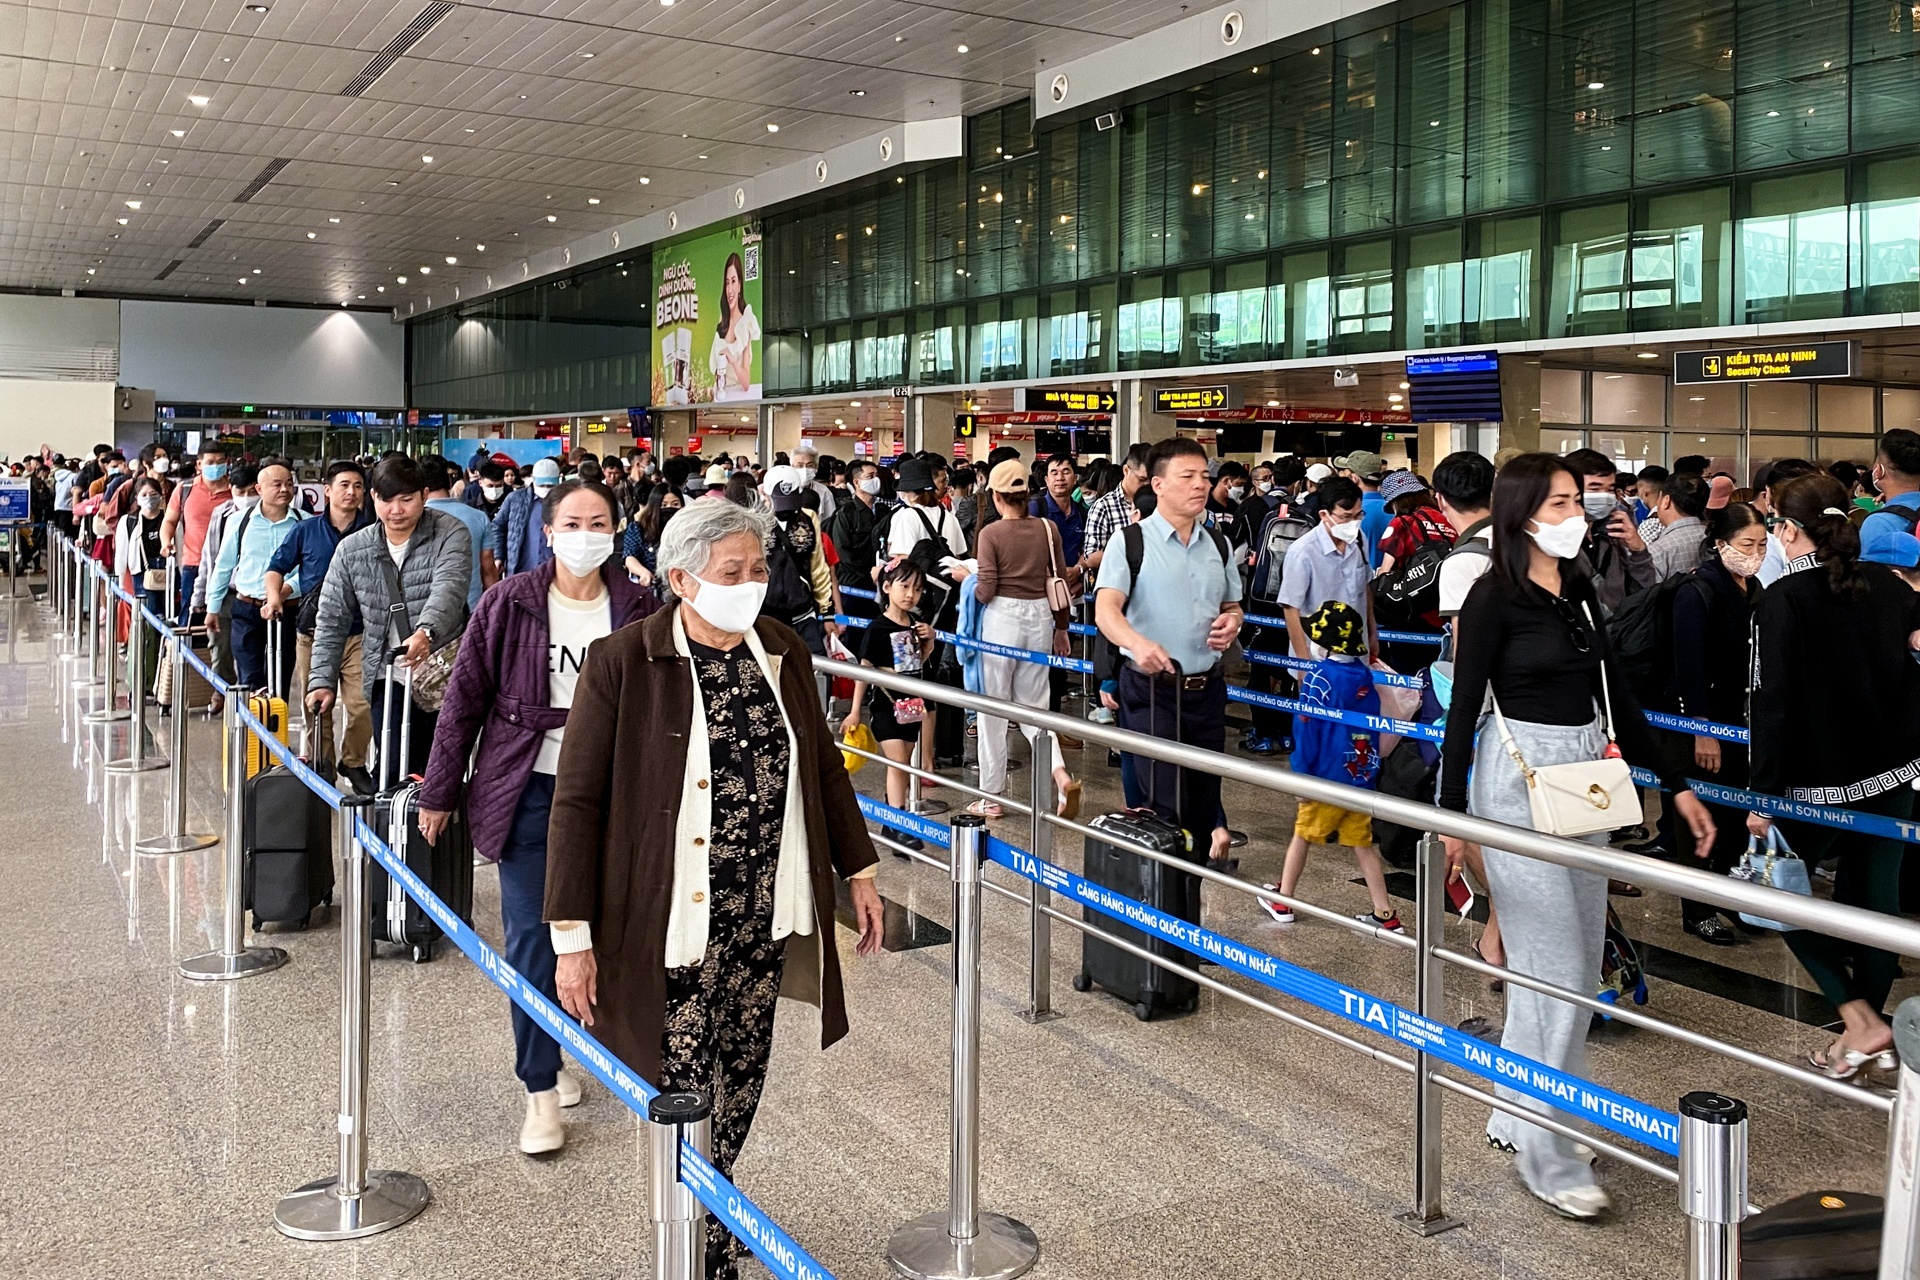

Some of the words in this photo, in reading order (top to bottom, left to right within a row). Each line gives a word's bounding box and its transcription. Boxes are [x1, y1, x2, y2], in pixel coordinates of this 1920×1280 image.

[677, 258, 690, 278] CỐC
[659, 281, 673, 298] DINH
[656, 294, 698, 327] BEONE
[1727, 351, 1750, 365] KIỂM
[1753, 354, 1772, 364] TRA
[1775, 352, 1789, 362] AN
[1791, 351, 1816, 361] NINH
[1726, 367, 1761, 376] Security
[1762, 365, 1790, 374] Check
[1262, 408, 1274, 418] K-1
[1282, 410, 1294, 419] K-2
[1360, 411, 1372, 421] K-3
[961, 416, 972, 436] J
[848, 617, 858, 626] TIA
[1047, 655, 1064, 667] TIA
[1282, 657, 1298, 668] KHÔNG
[1300, 661, 1314, 670] QUỐC
[1385, 674, 1407, 686] TIA
[1241, 690, 1256, 701] HÀNG
[1257, 694, 1276, 706] KHÔNG
[1277, 698, 1292, 710] QUỐC
[1293, 701, 1300, 711] TẾ
[1301, 704, 1312, 714] TÂN
[1366, 716, 1390, 730] TIA
[1424, 727, 1438, 738] TAN
[1654, 714, 1676, 726] HÀNG
[1678, 720, 1708, 732] KHÔNG
[1710, 726, 1735, 738] QUỐC
[1737, 728, 1749, 740] TẾ
[1631, 768, 1652, 783] ẢNG
[1690, 783, 1720, 798] HÔNG
[1722, 790, 1752, 805] QUỐC
[1755, 796, 1769, 810] TẾ
[1771, 798, 1793, 814] TÂN
[1796, 804, 1820, 820] SƠN
[1823, 810, 1855, 826] NHẤT
[874, 805, 922, 833] INTERNATIONAL
[358, 822, 370, 846] TIA
[1010, 850, 1038, 878] TIA
[1077, 882, 1100, 903] CẢNG
[1100, 894, 1124, 914] HÀNG
[1126, 904, 1158, 928] KHÔNG
[1159, 918, 1186, 940] QUỐC
[1187, 929, 1200, 948] TẾ
[1202, 936, 1222, 956] TÂN
[1224, 946, 1246, 966] SƠN
[1249, 956, 1278, 978] NHẤT
[479, 941, 498, 976] TIA
[1338, 989, 1389, 1030] TIA
[1398, 1010, 1410, 1022] TAN
[1411, 1016, 1426, 1028] SON
[1426, 1022, 1444, 1036] NHAT
[1398, 1020, 1448, 1047] INTERNATIONAL
[1398, 1030, 1426, 1048] AIRPORT
[522, 984, 534, 1008] TAN
[534, 996, 547, 1018] SON
[547, 1007, 564, 1033] NHAT
[564, 1022, 614, 1080] INTERNATIONAL
[614, 1067, 648, 1108] AIRPORT
[1462, 1042, 1492, 1070] TAN
[1495, 1058, 1529, 1085] SON
[1532, 1071, 1578, 1103] NHAT
[1581, 1090, 1680, 1144] INTERNATI
[728, 1196, 759, 1239] CẢNG
[760, 1226, 796, 1274] HÀNG
